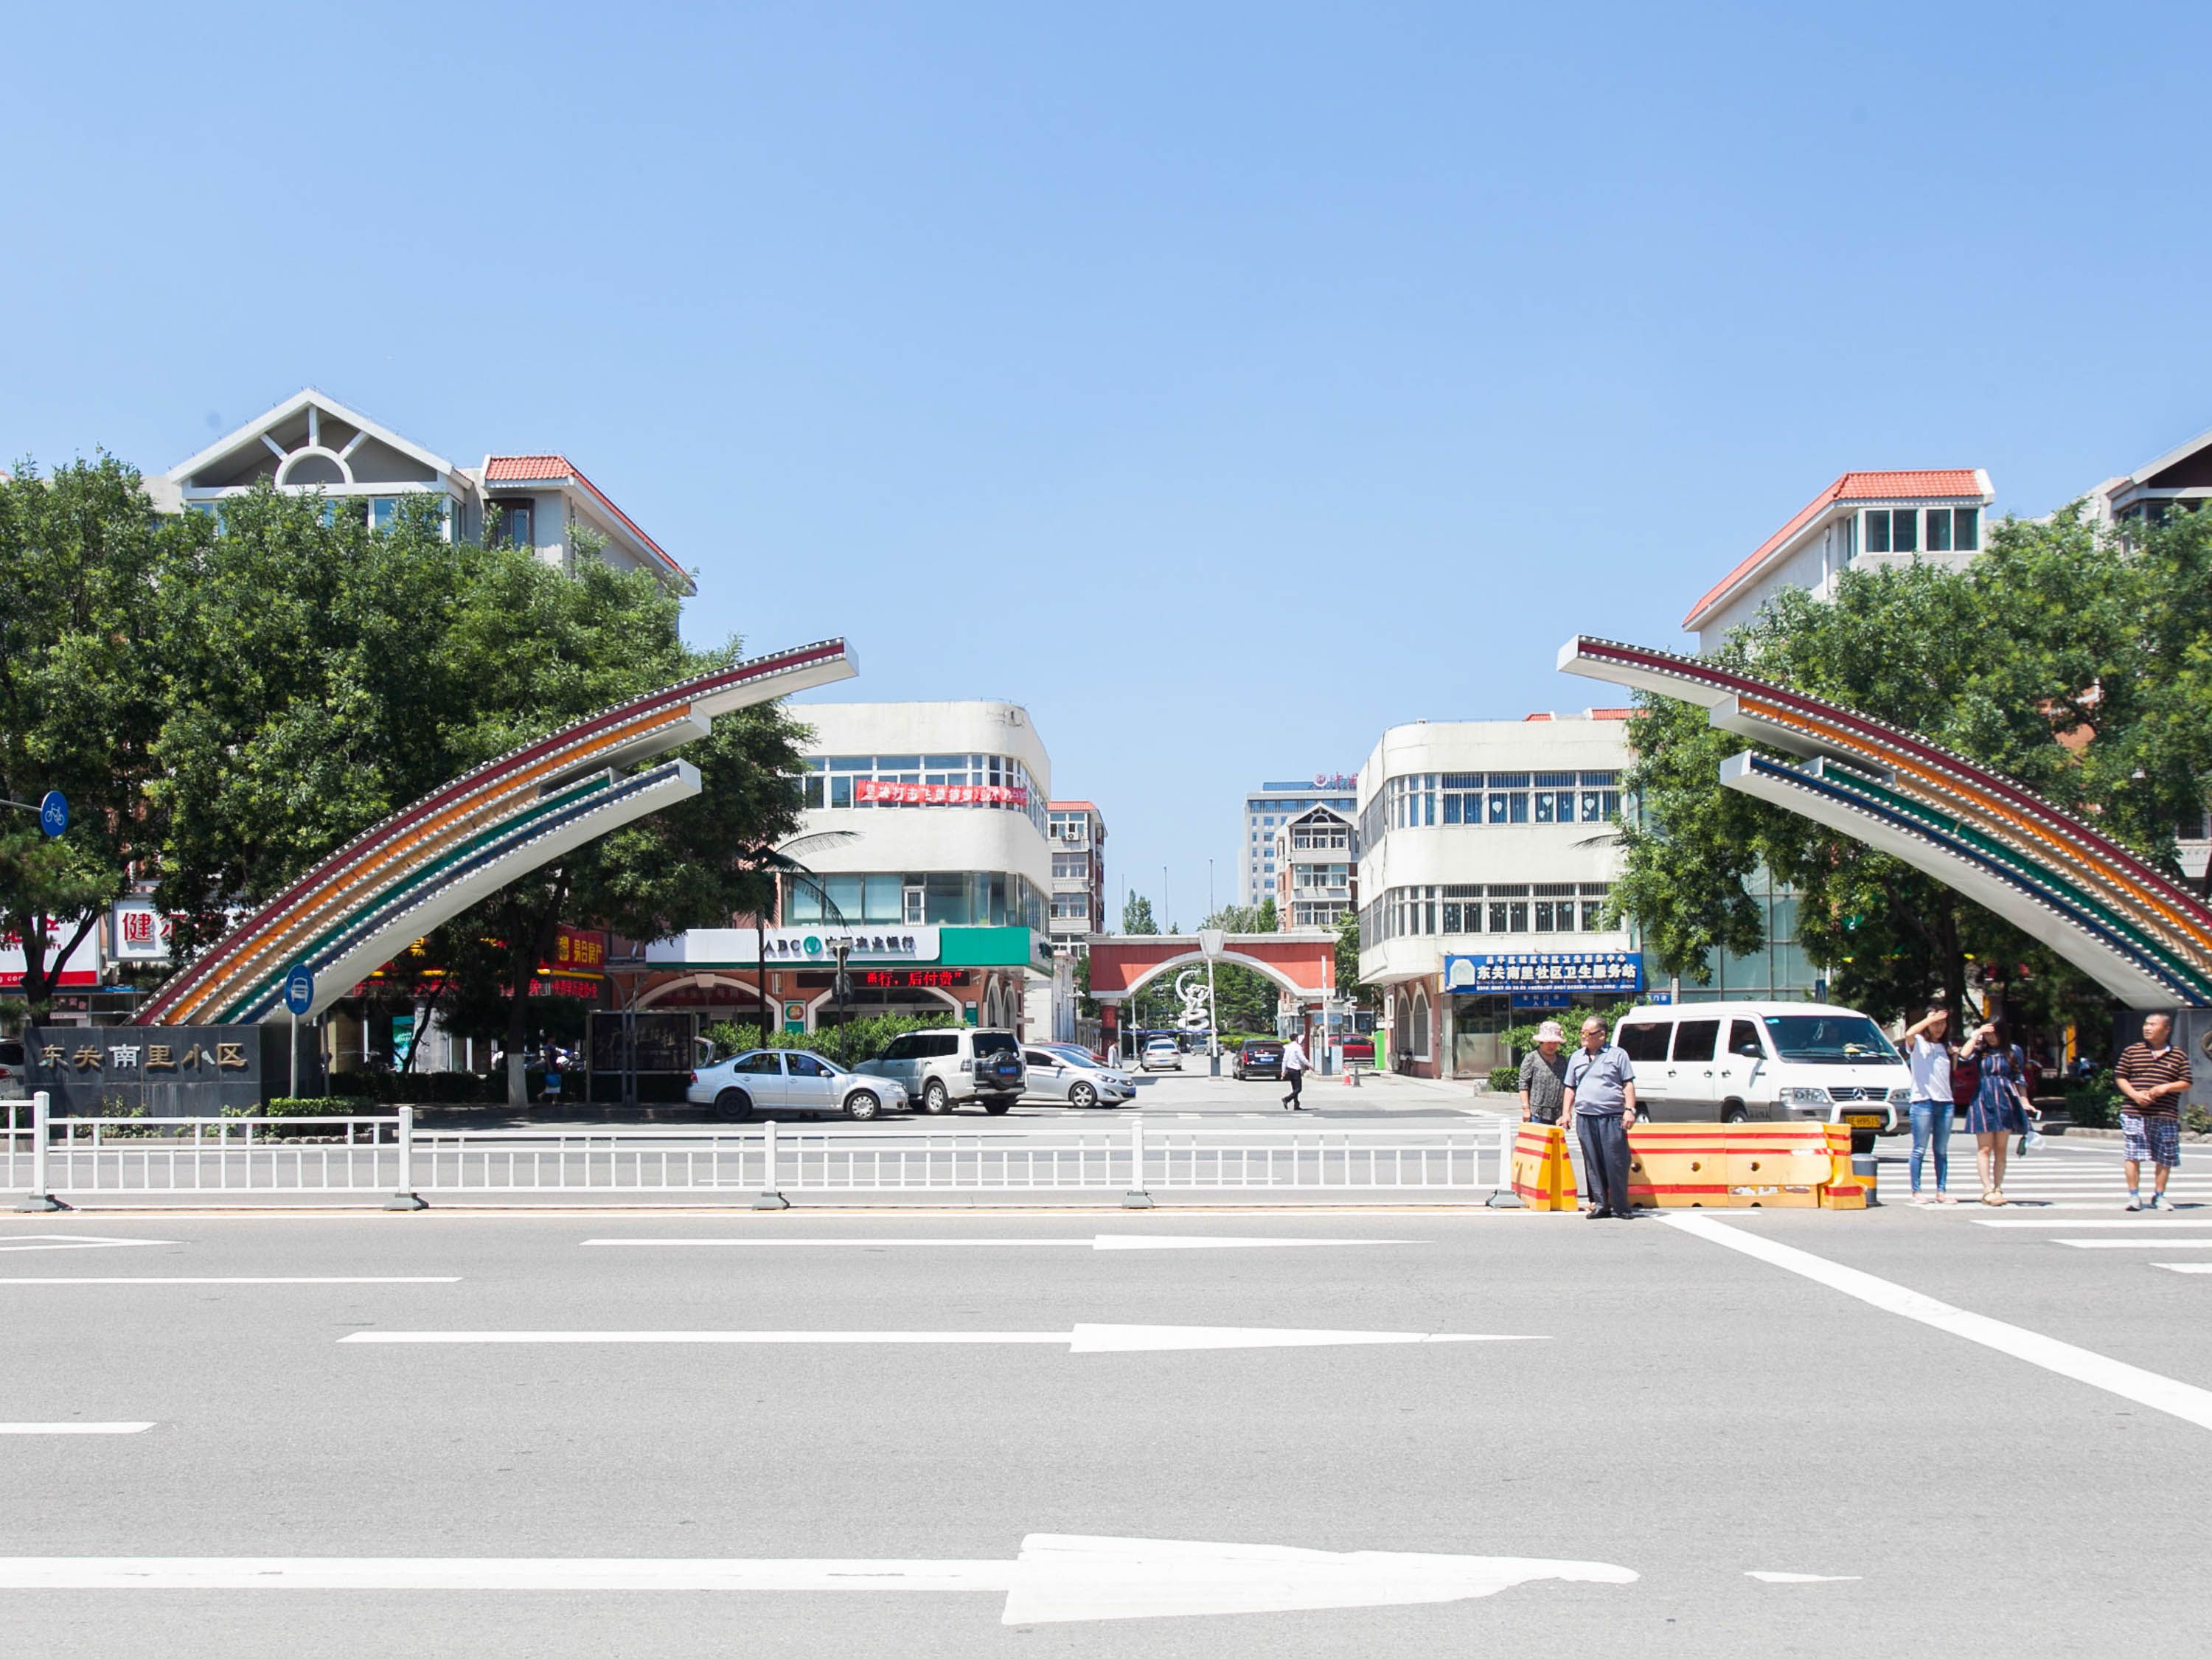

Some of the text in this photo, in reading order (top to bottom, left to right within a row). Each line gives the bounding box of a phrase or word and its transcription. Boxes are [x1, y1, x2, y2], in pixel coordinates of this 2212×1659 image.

[764, 940, 800, 951] ABC
[1477, 964, 1636, 980] 东关南里社区卫生服务站
[38, 1043, 248, 1069] 东关南里小区
